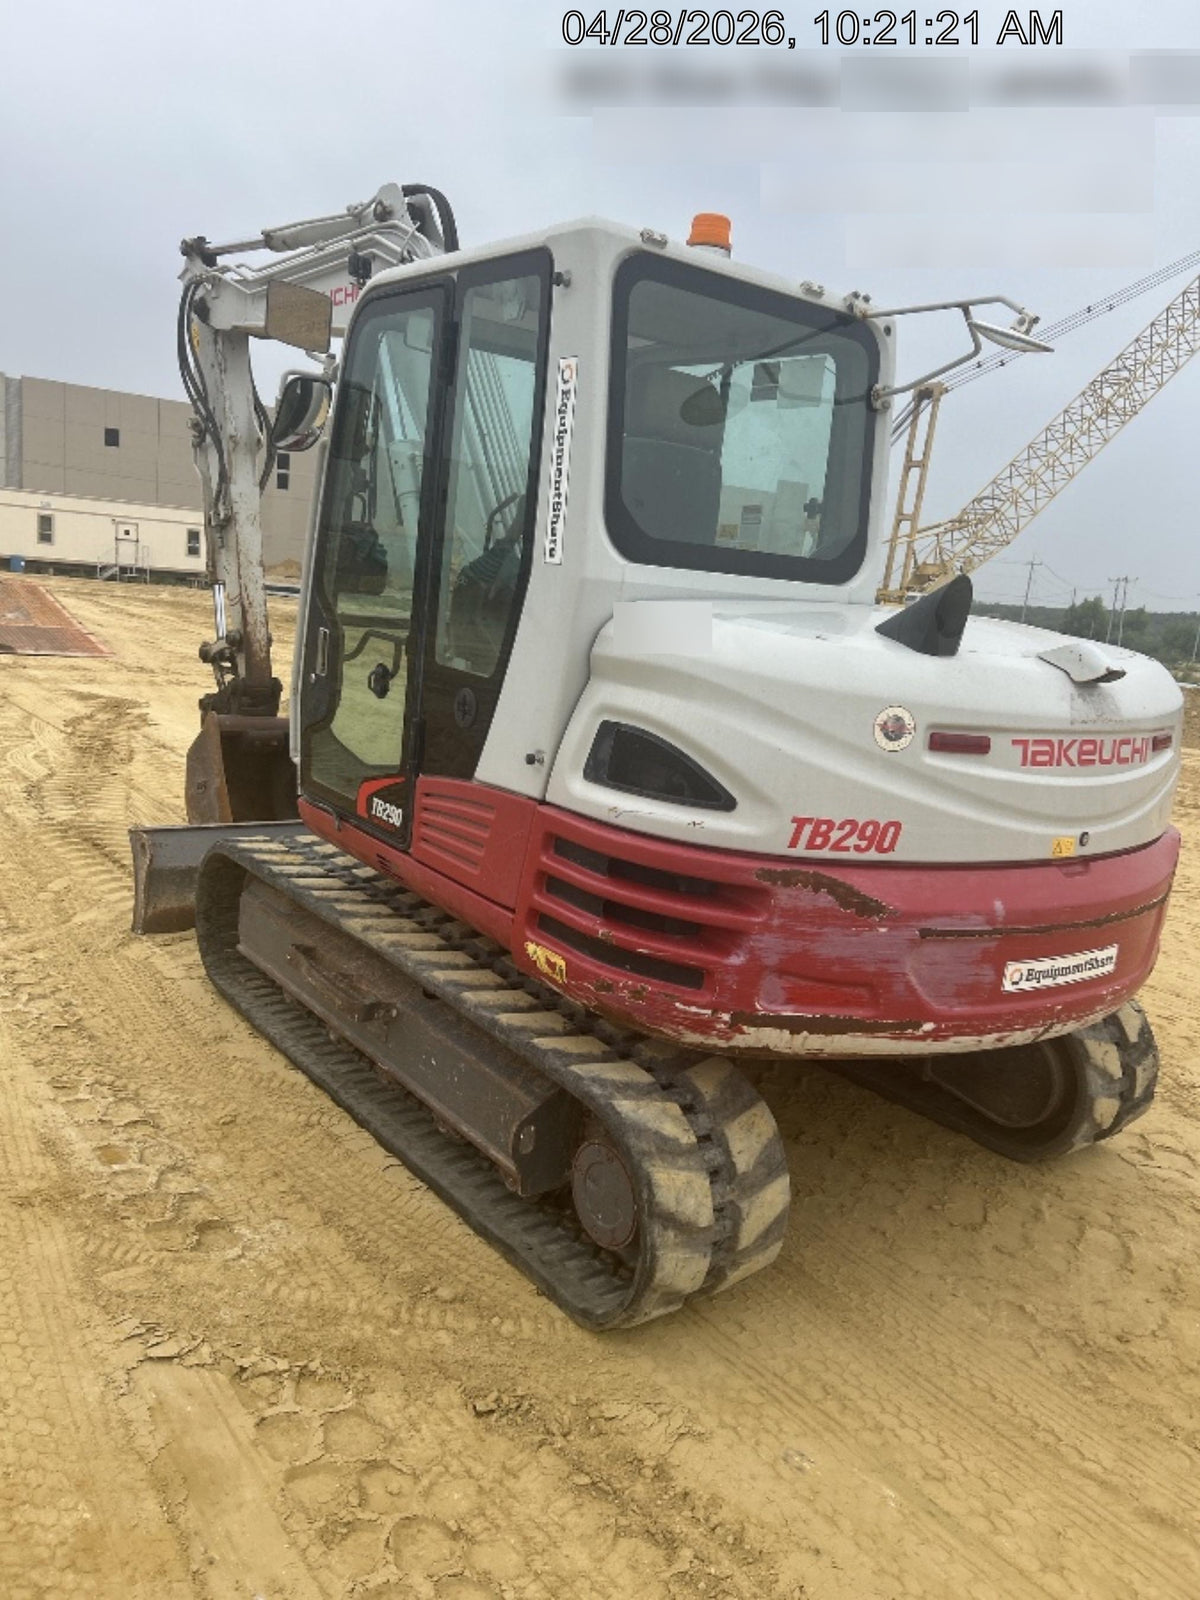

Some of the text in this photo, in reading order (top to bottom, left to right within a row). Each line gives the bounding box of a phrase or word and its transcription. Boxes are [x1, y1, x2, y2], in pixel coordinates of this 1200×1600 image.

[1011, 737, 1149, 767] TAKEUCHI
[372, 796, 402, 827] TB290
[787, 816, 902, 854] TB290
